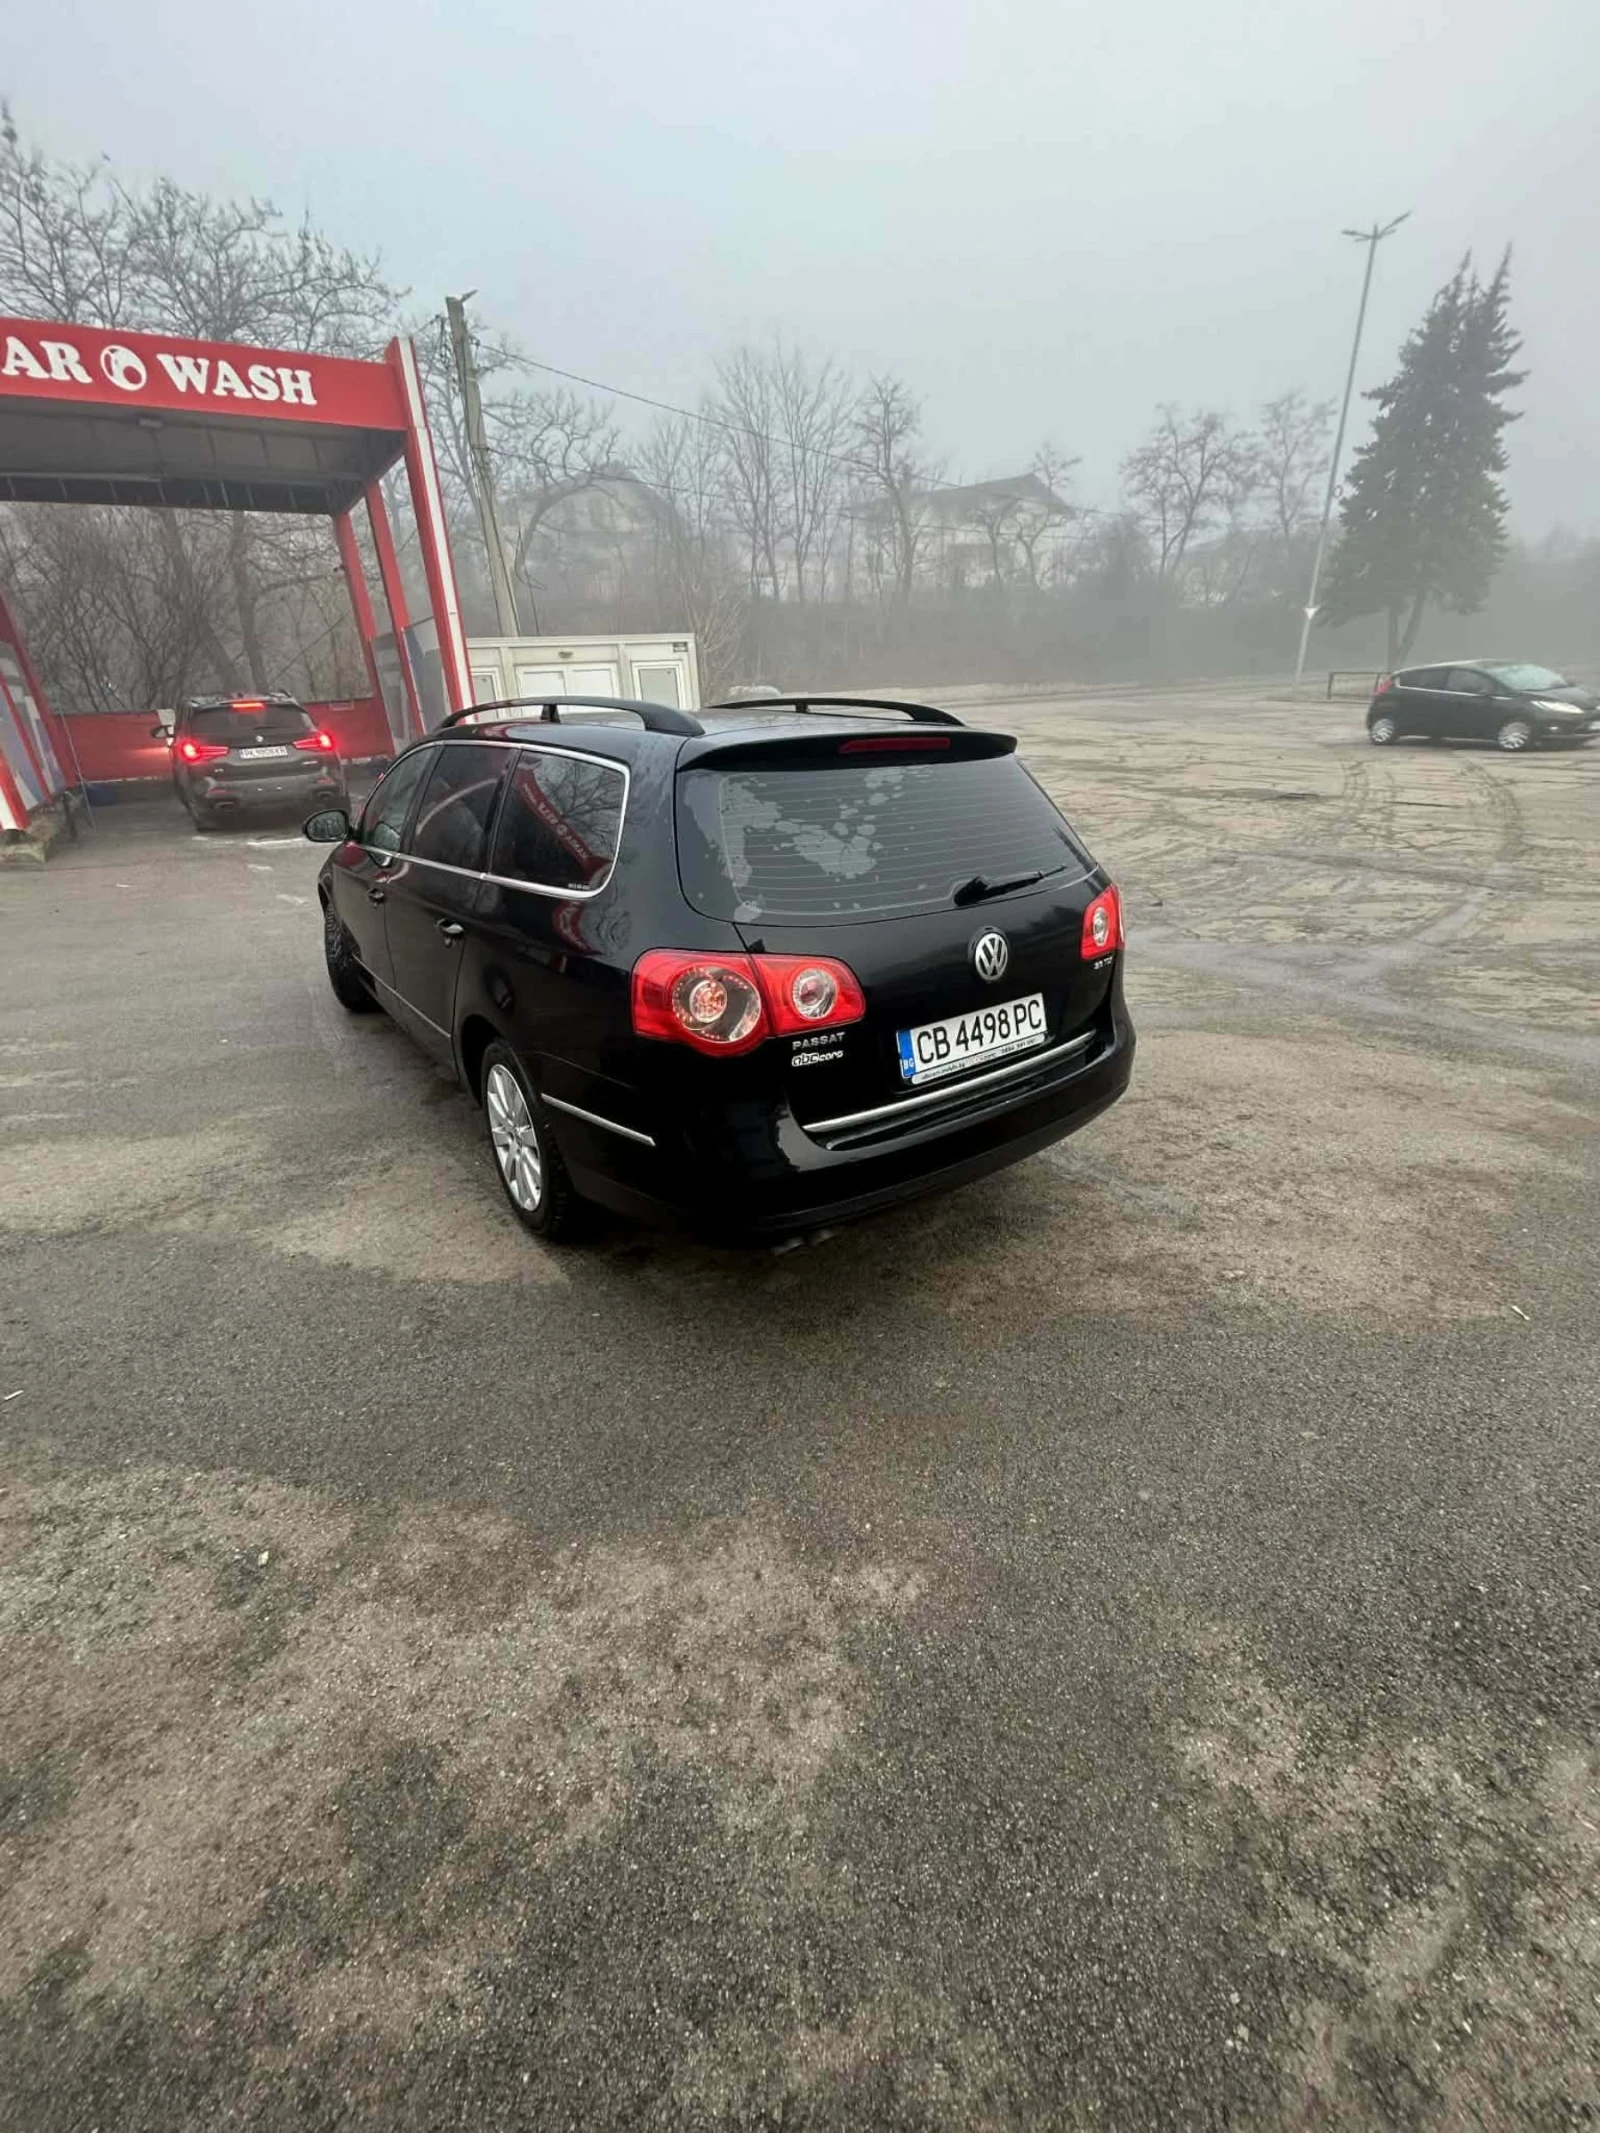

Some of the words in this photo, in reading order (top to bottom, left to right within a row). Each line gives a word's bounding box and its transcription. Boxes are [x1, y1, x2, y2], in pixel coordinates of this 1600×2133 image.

[1, 336, 93, 384] AR
[156, 353, 318, 405] WASH
[792, 1031, 846, 1050] PASSAT
[917, 1026, 951, 1064] CB
[956, 1008, 1011, 1051] 4498
[1013, 999, 1042, 1035] PC
[903, 1058, 914, 1069] BG
